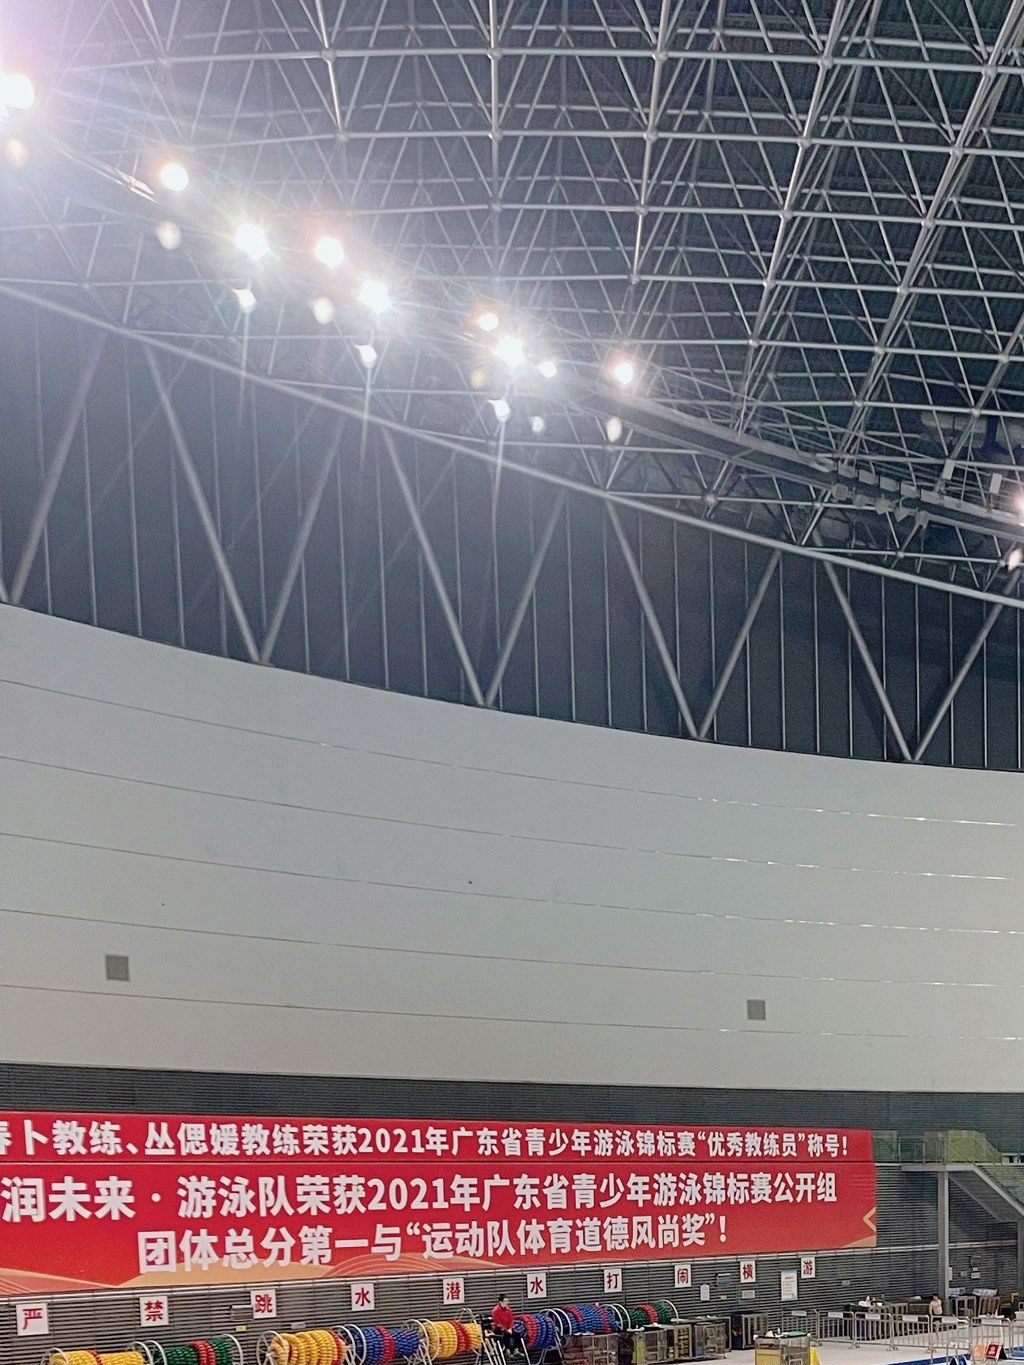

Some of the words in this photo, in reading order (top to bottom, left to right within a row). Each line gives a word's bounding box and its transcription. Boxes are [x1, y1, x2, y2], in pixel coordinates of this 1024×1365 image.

[22, 1306, 44, 1330] 严
[144, 1299, 165, 1322] 禁
[254, 1293, 274, 1314] 跳
[355, 1288, 371, 1306] 水
